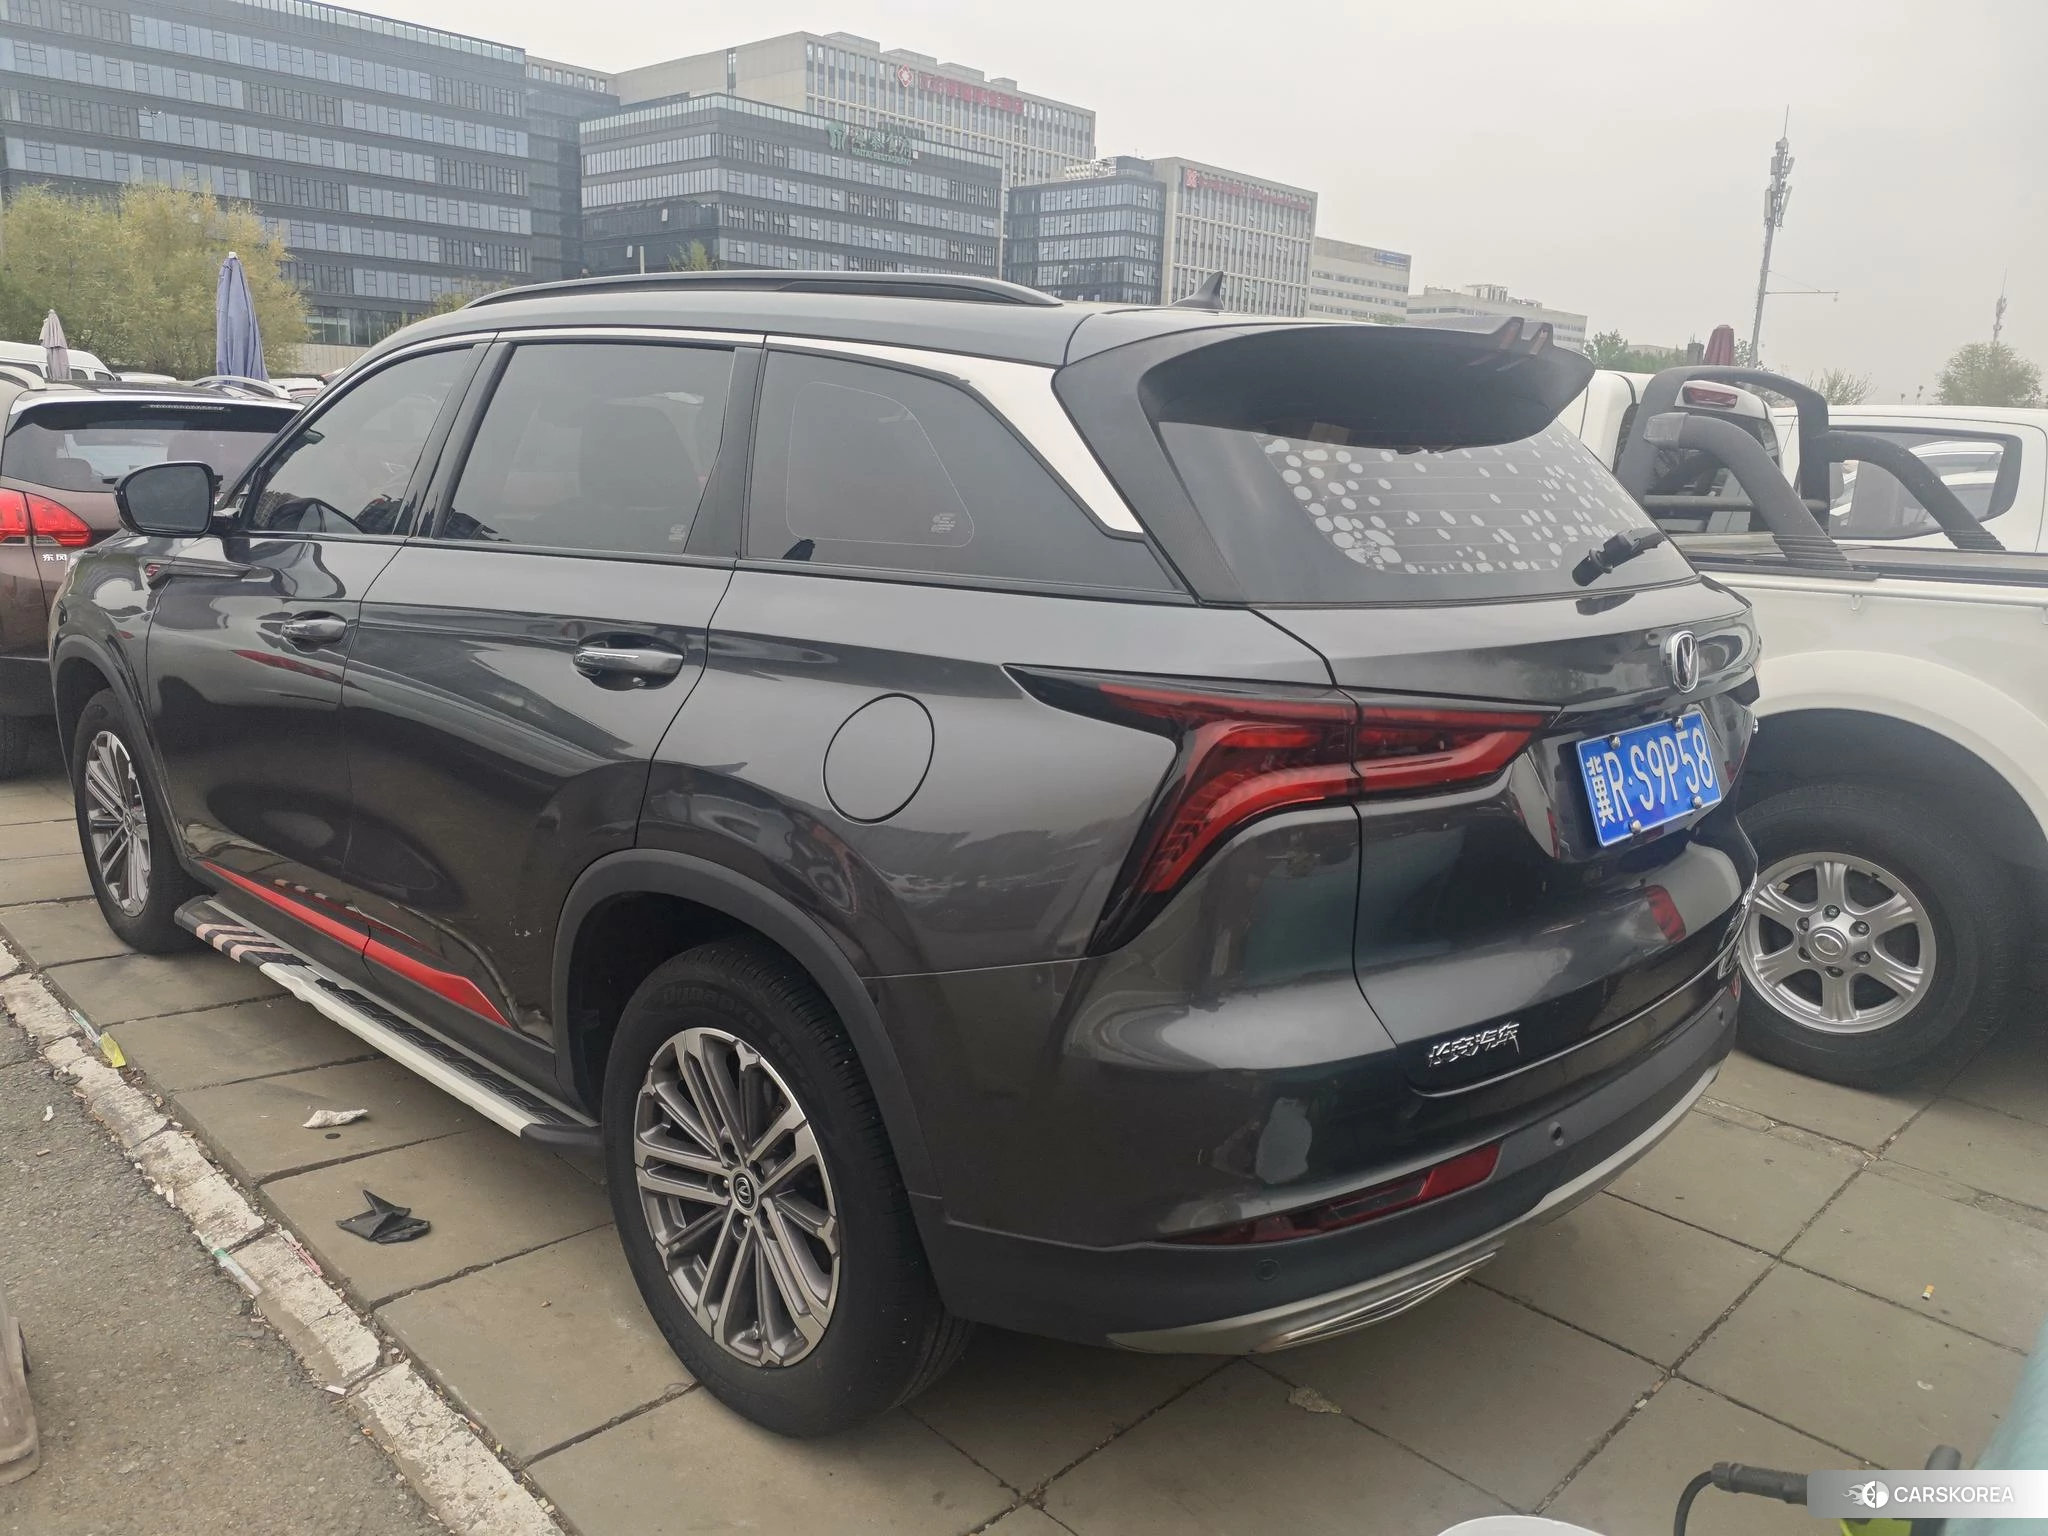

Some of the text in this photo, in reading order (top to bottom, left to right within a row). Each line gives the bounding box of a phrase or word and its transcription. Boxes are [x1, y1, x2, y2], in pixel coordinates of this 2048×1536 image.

[42, 553, 67, 562] 东风
[1427, 1020, 1520, 1067] 长安汽车
